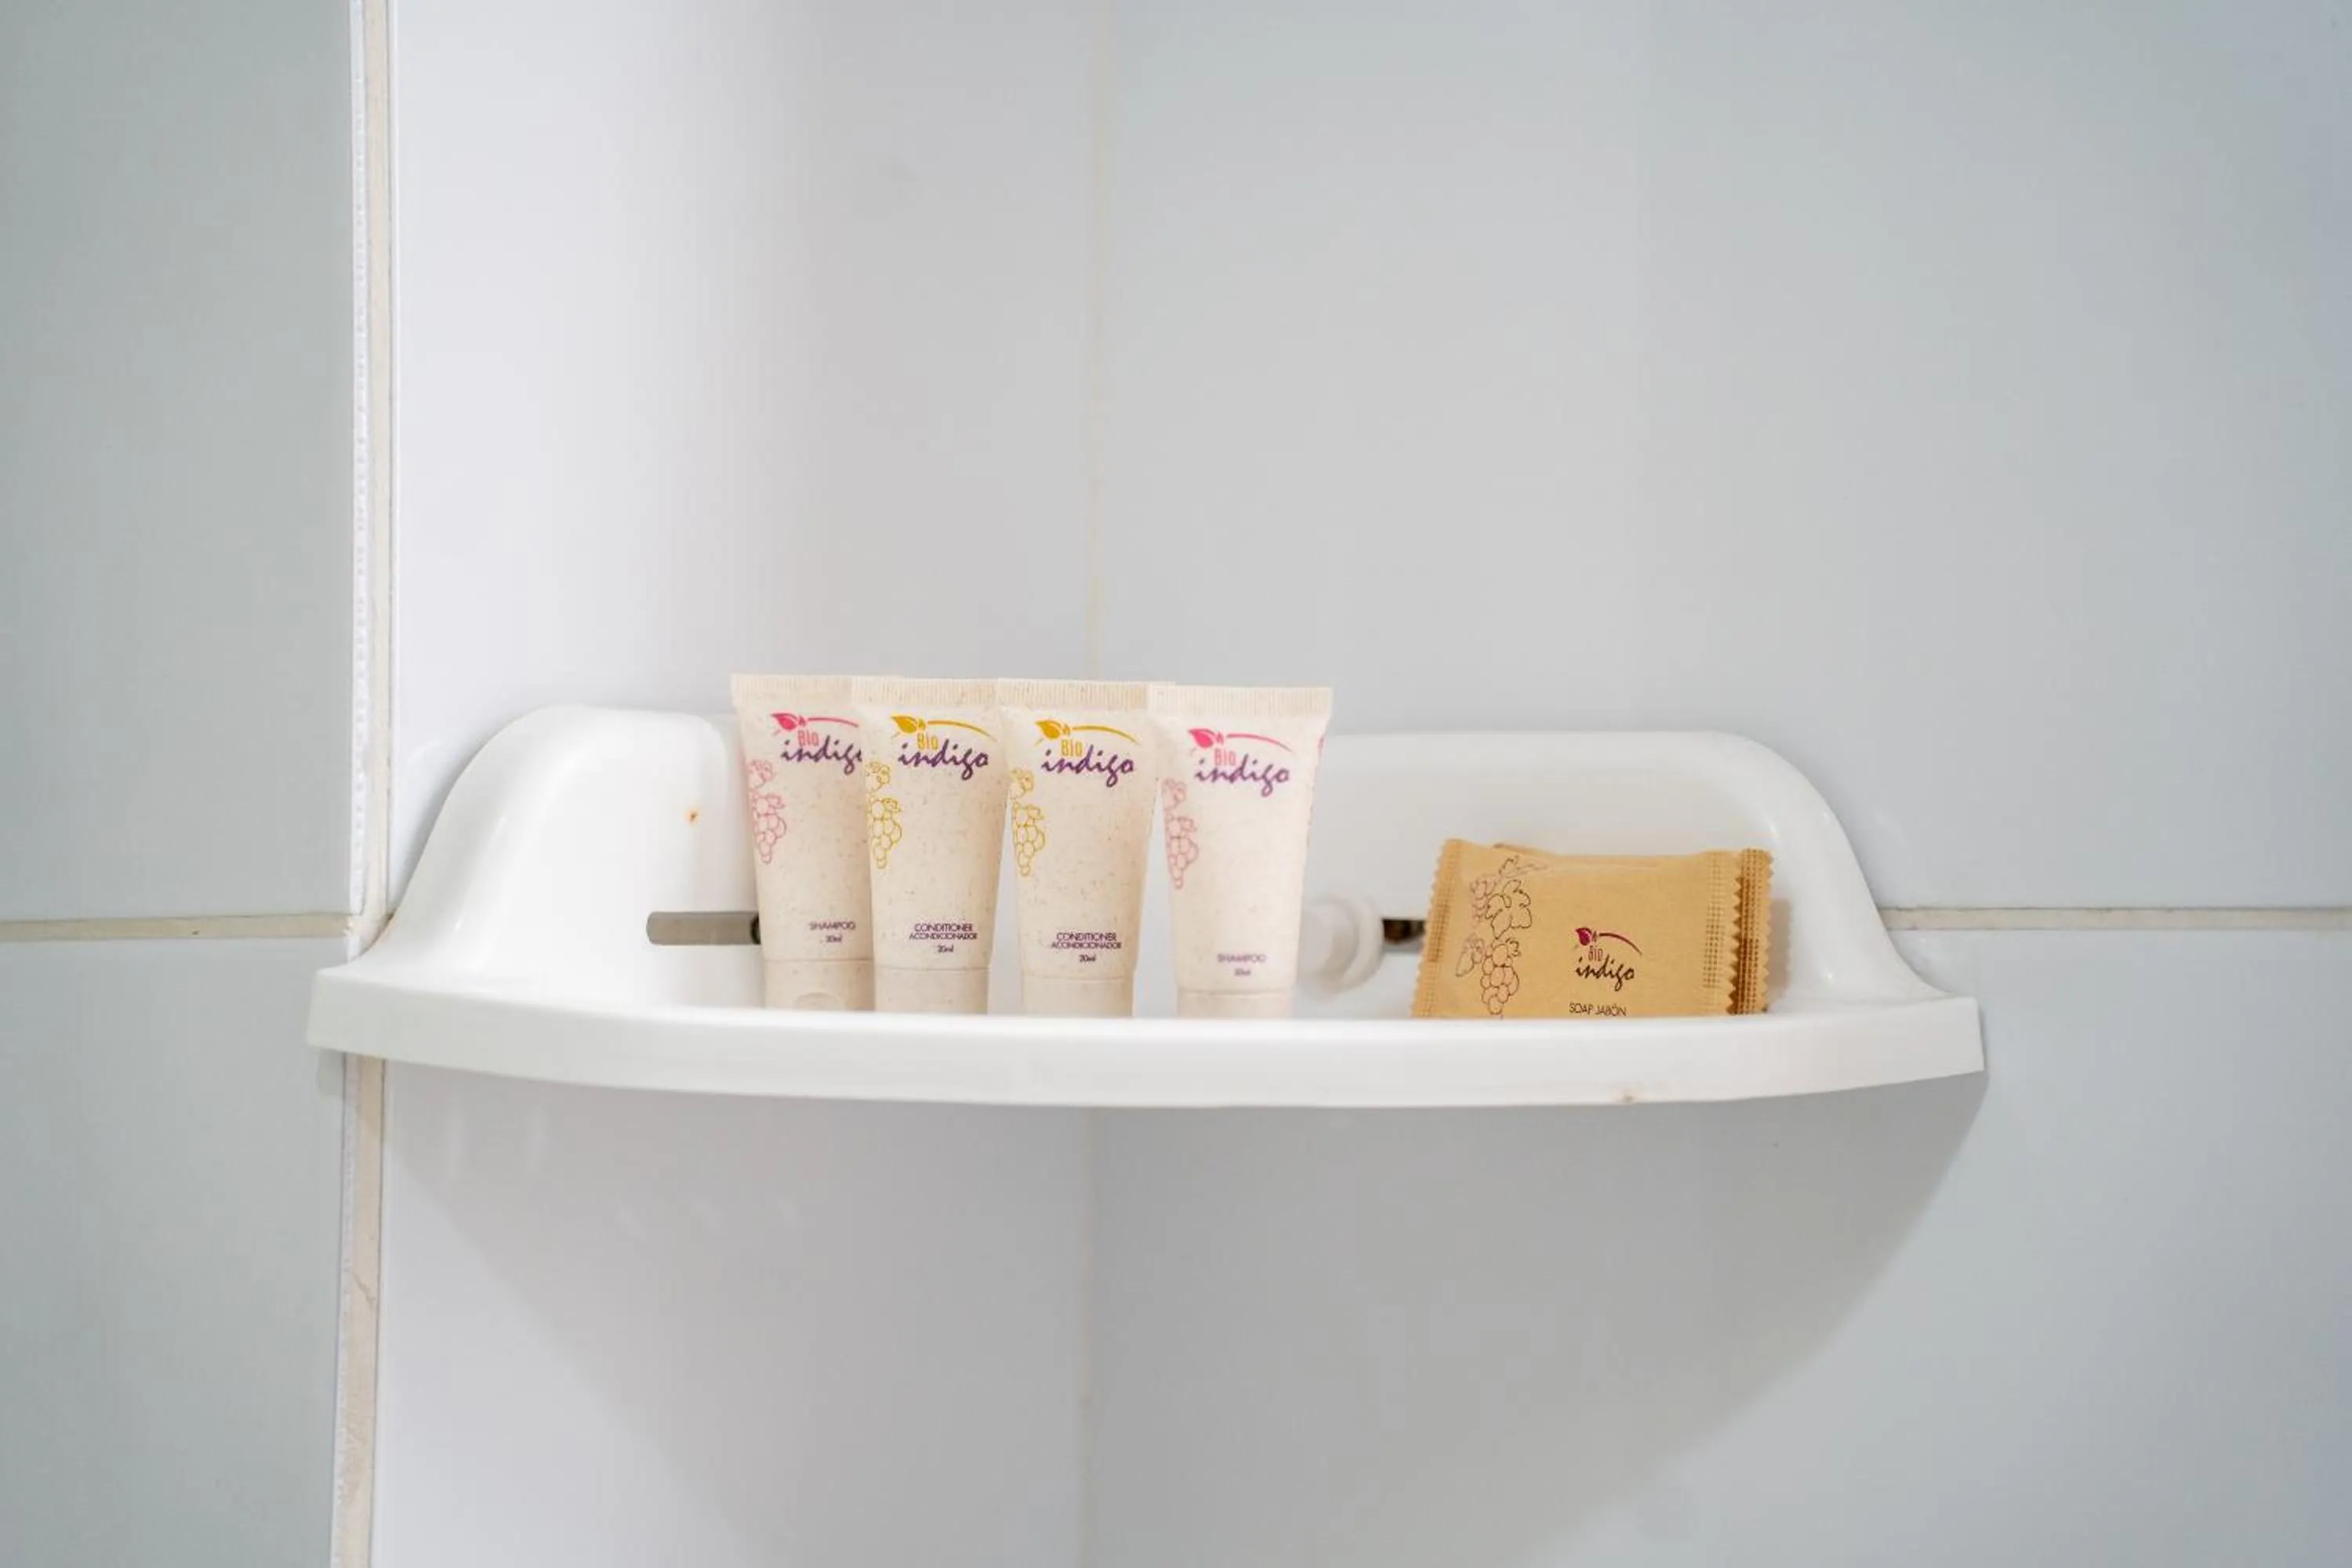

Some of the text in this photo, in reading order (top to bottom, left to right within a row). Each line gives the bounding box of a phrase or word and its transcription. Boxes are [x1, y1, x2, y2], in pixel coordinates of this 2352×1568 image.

[898, 738, 989, 781] indigo
[1040, 743, 1134, 788] indigo
[1194, 753, 1290, 798] indigo
[809, 920, 856, 931] SHAMPOO
[913, 923, 973, 932] CONDITIONER
[1056, 932, 1117, 942] CONDITIONER
[1217, 953, 1268, 963] SHAMPOO
[1575, 954, 1635, 992] indigo
[1569, 1002, 1594, 1015] SOAP
